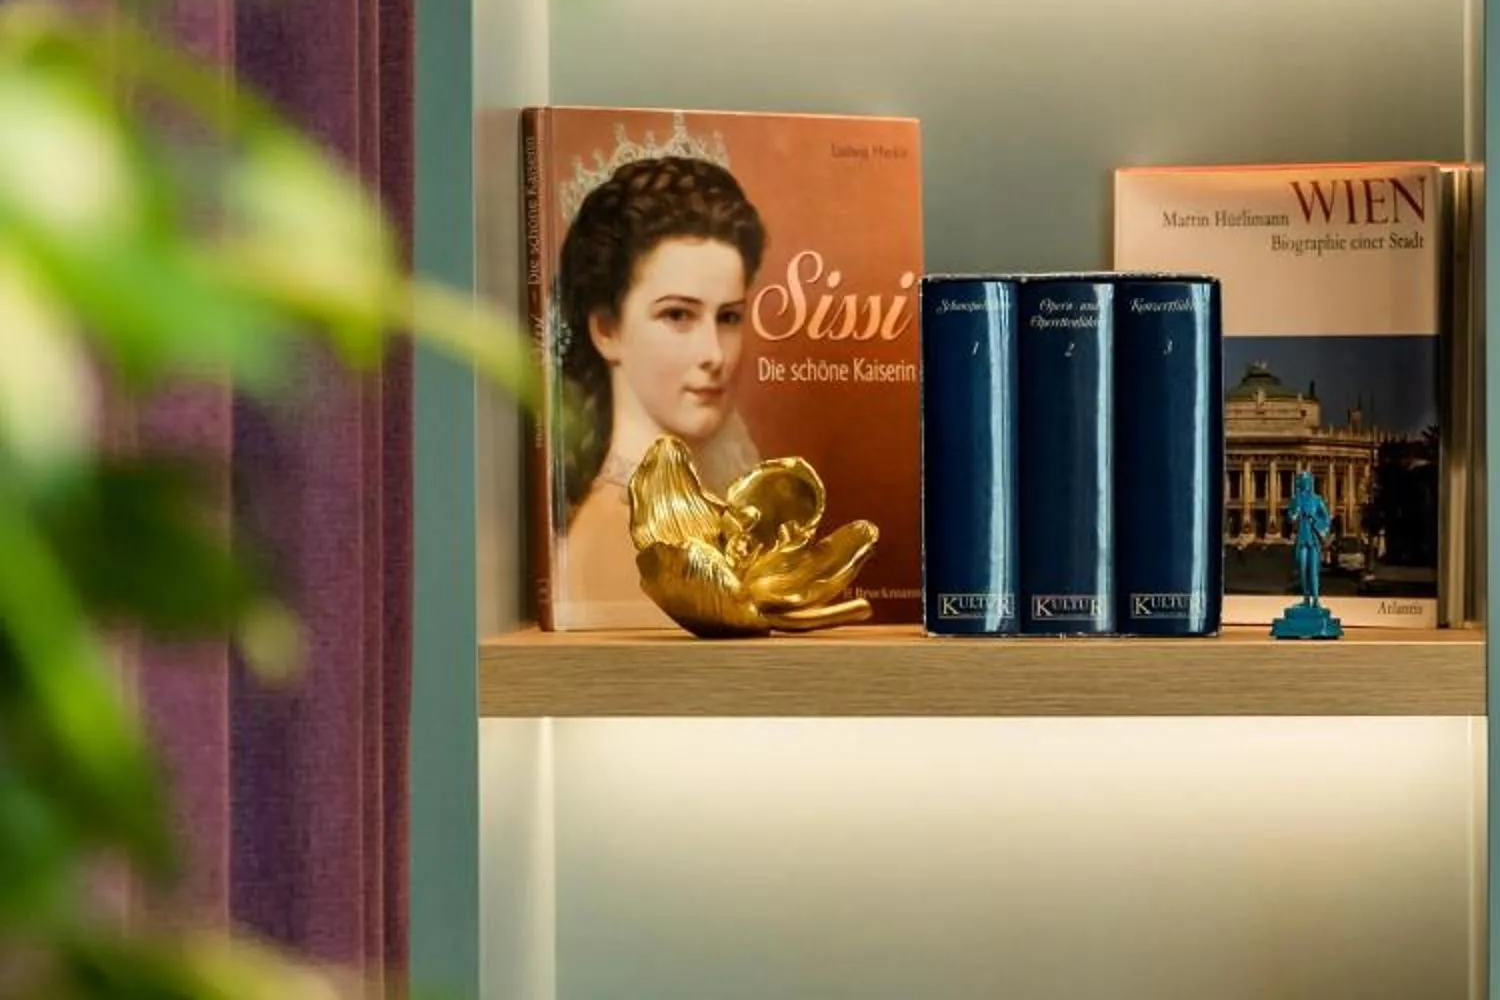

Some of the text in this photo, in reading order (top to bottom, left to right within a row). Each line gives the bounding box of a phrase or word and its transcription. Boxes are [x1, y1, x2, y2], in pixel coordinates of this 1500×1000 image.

[1289, 176, 1427, 226] WIEN
[1162, 210, 1210, 229] Martin
[1271, 231, 1425, 258] Biographie einer Stadt
[752, 250, 915, 341] Sissi
[758, 356, 915, 382] Die schöne Kaiserin
[1375, 600, 1424, 615] Atlantis
